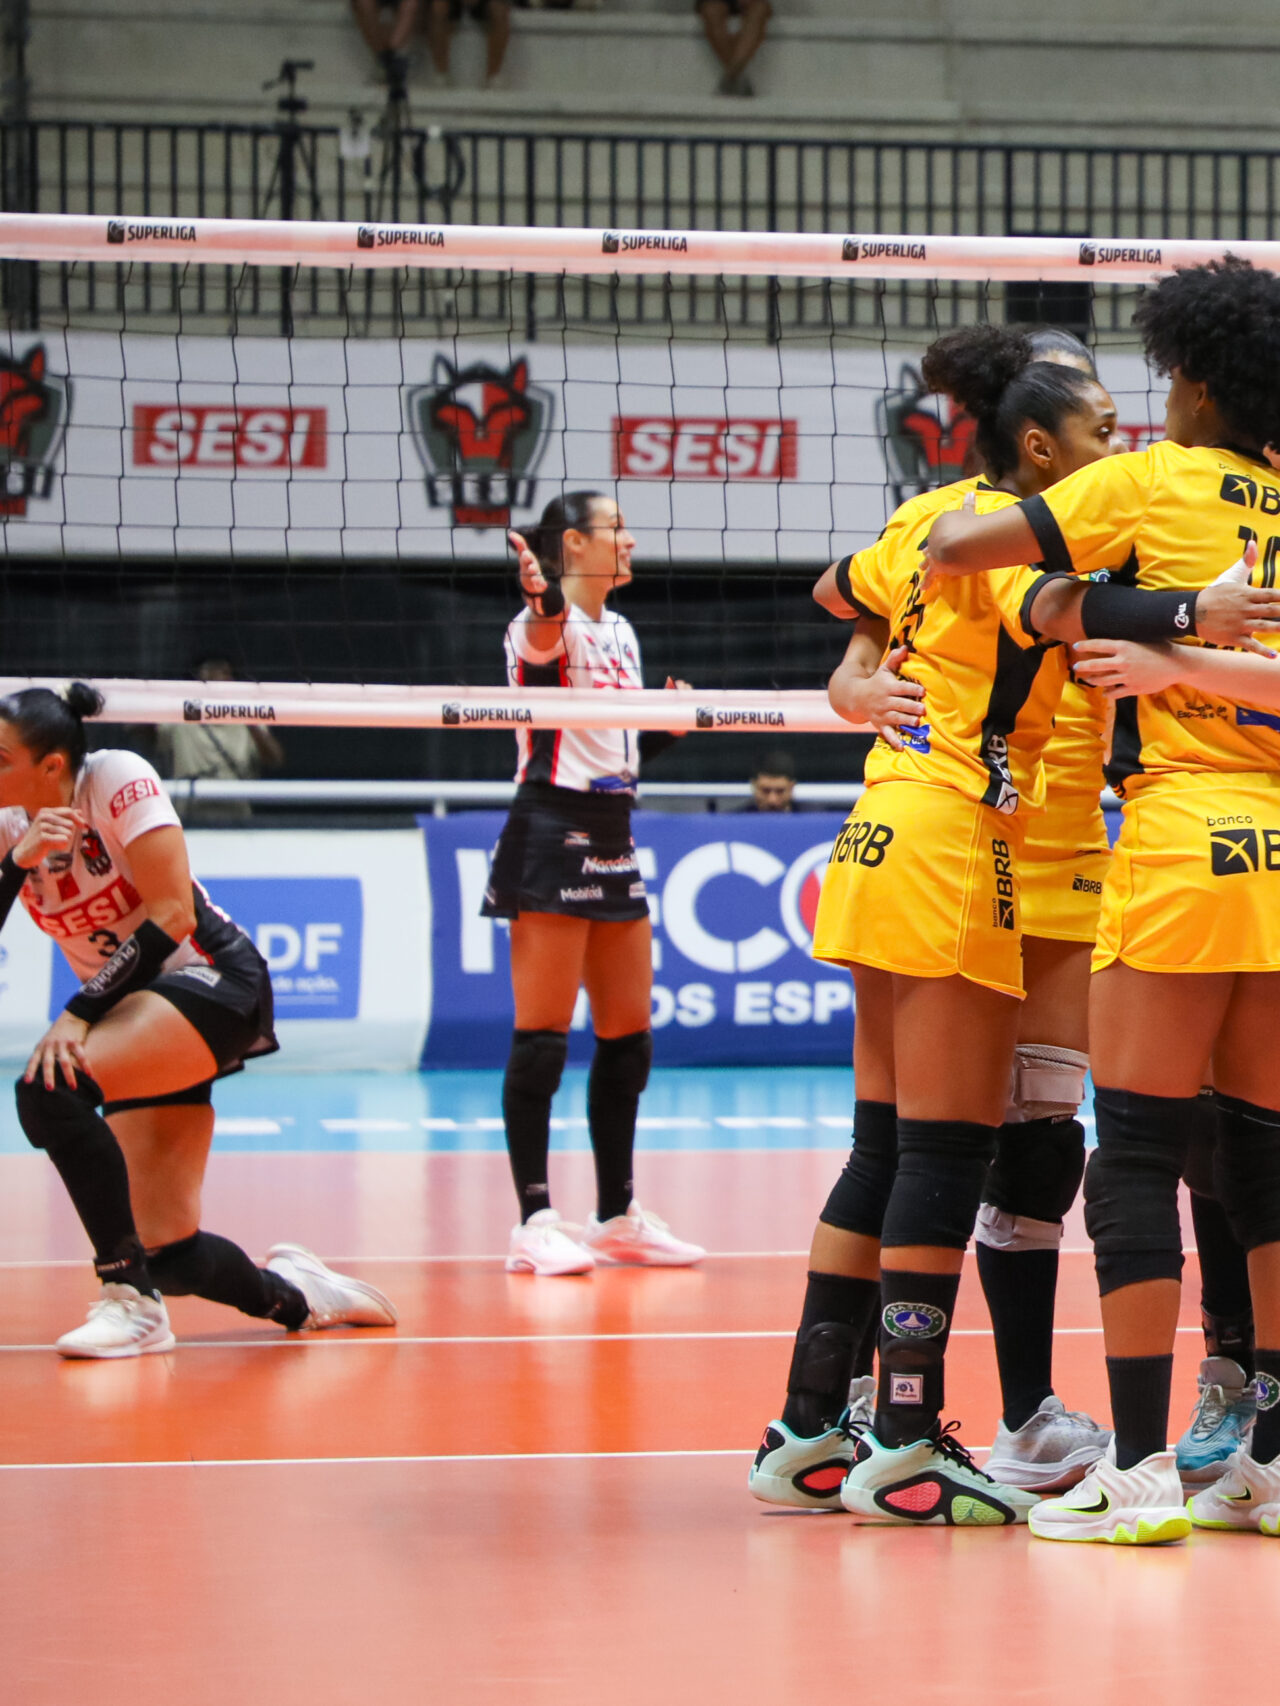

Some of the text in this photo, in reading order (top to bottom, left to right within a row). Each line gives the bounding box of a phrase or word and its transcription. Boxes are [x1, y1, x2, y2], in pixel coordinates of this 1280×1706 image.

[127, 224, 197, 242] SUPERLIGA
[377, 230, 444, 247] SUPERLIGA
[621, 235, 688, 252] SUPERLIGA
[861, 242, 926, 260] SUPERLIGA
[1098, 247, 1162, 264] SUPERLIGA
[149, 411, 310, 464] SESI
[626, 423, 781, 474] SESI
[204, 704, 276, 721] SUPERLIGA
[462, 708, 533, 724] SUPERLIGA
[716, 711, 785, 727] SUPERLIGA
[112, 779, 155, 814] SESI
[1206, 815, 1253, 827] banco
[837, 821, 894, 868] BRB
[992, 838, 1014, 898] BRB
[1082, 879, 1102, 895] BRB
[39, 885, 131, 938] SESI
[88, 928, 122, 958] 3
[733, 979, 856, 1026] ESP
